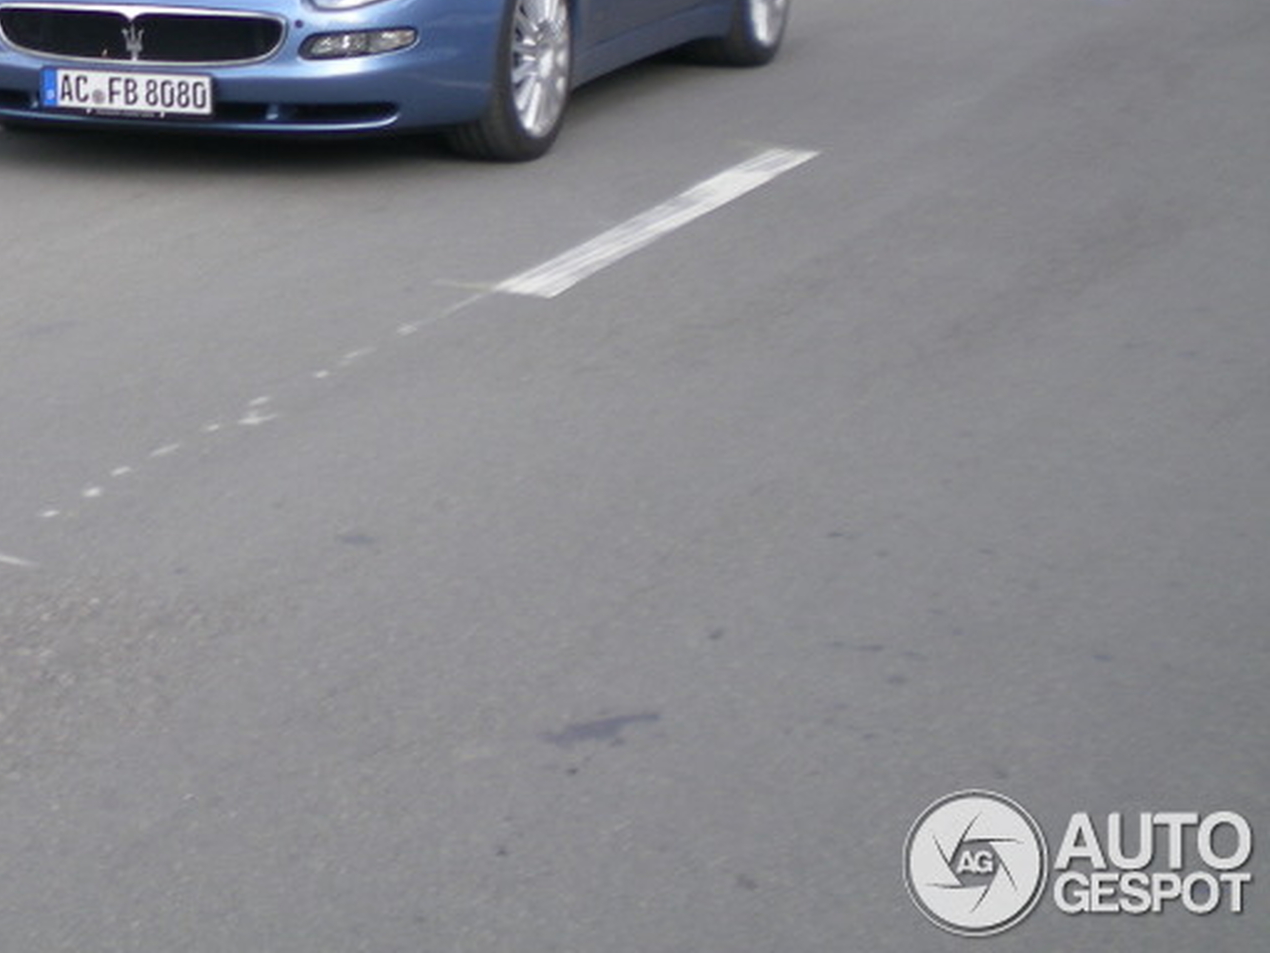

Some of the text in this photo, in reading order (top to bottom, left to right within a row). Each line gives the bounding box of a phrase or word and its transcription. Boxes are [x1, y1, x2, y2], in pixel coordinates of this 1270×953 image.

[60, 74, 207, 110] AC FB 8080
